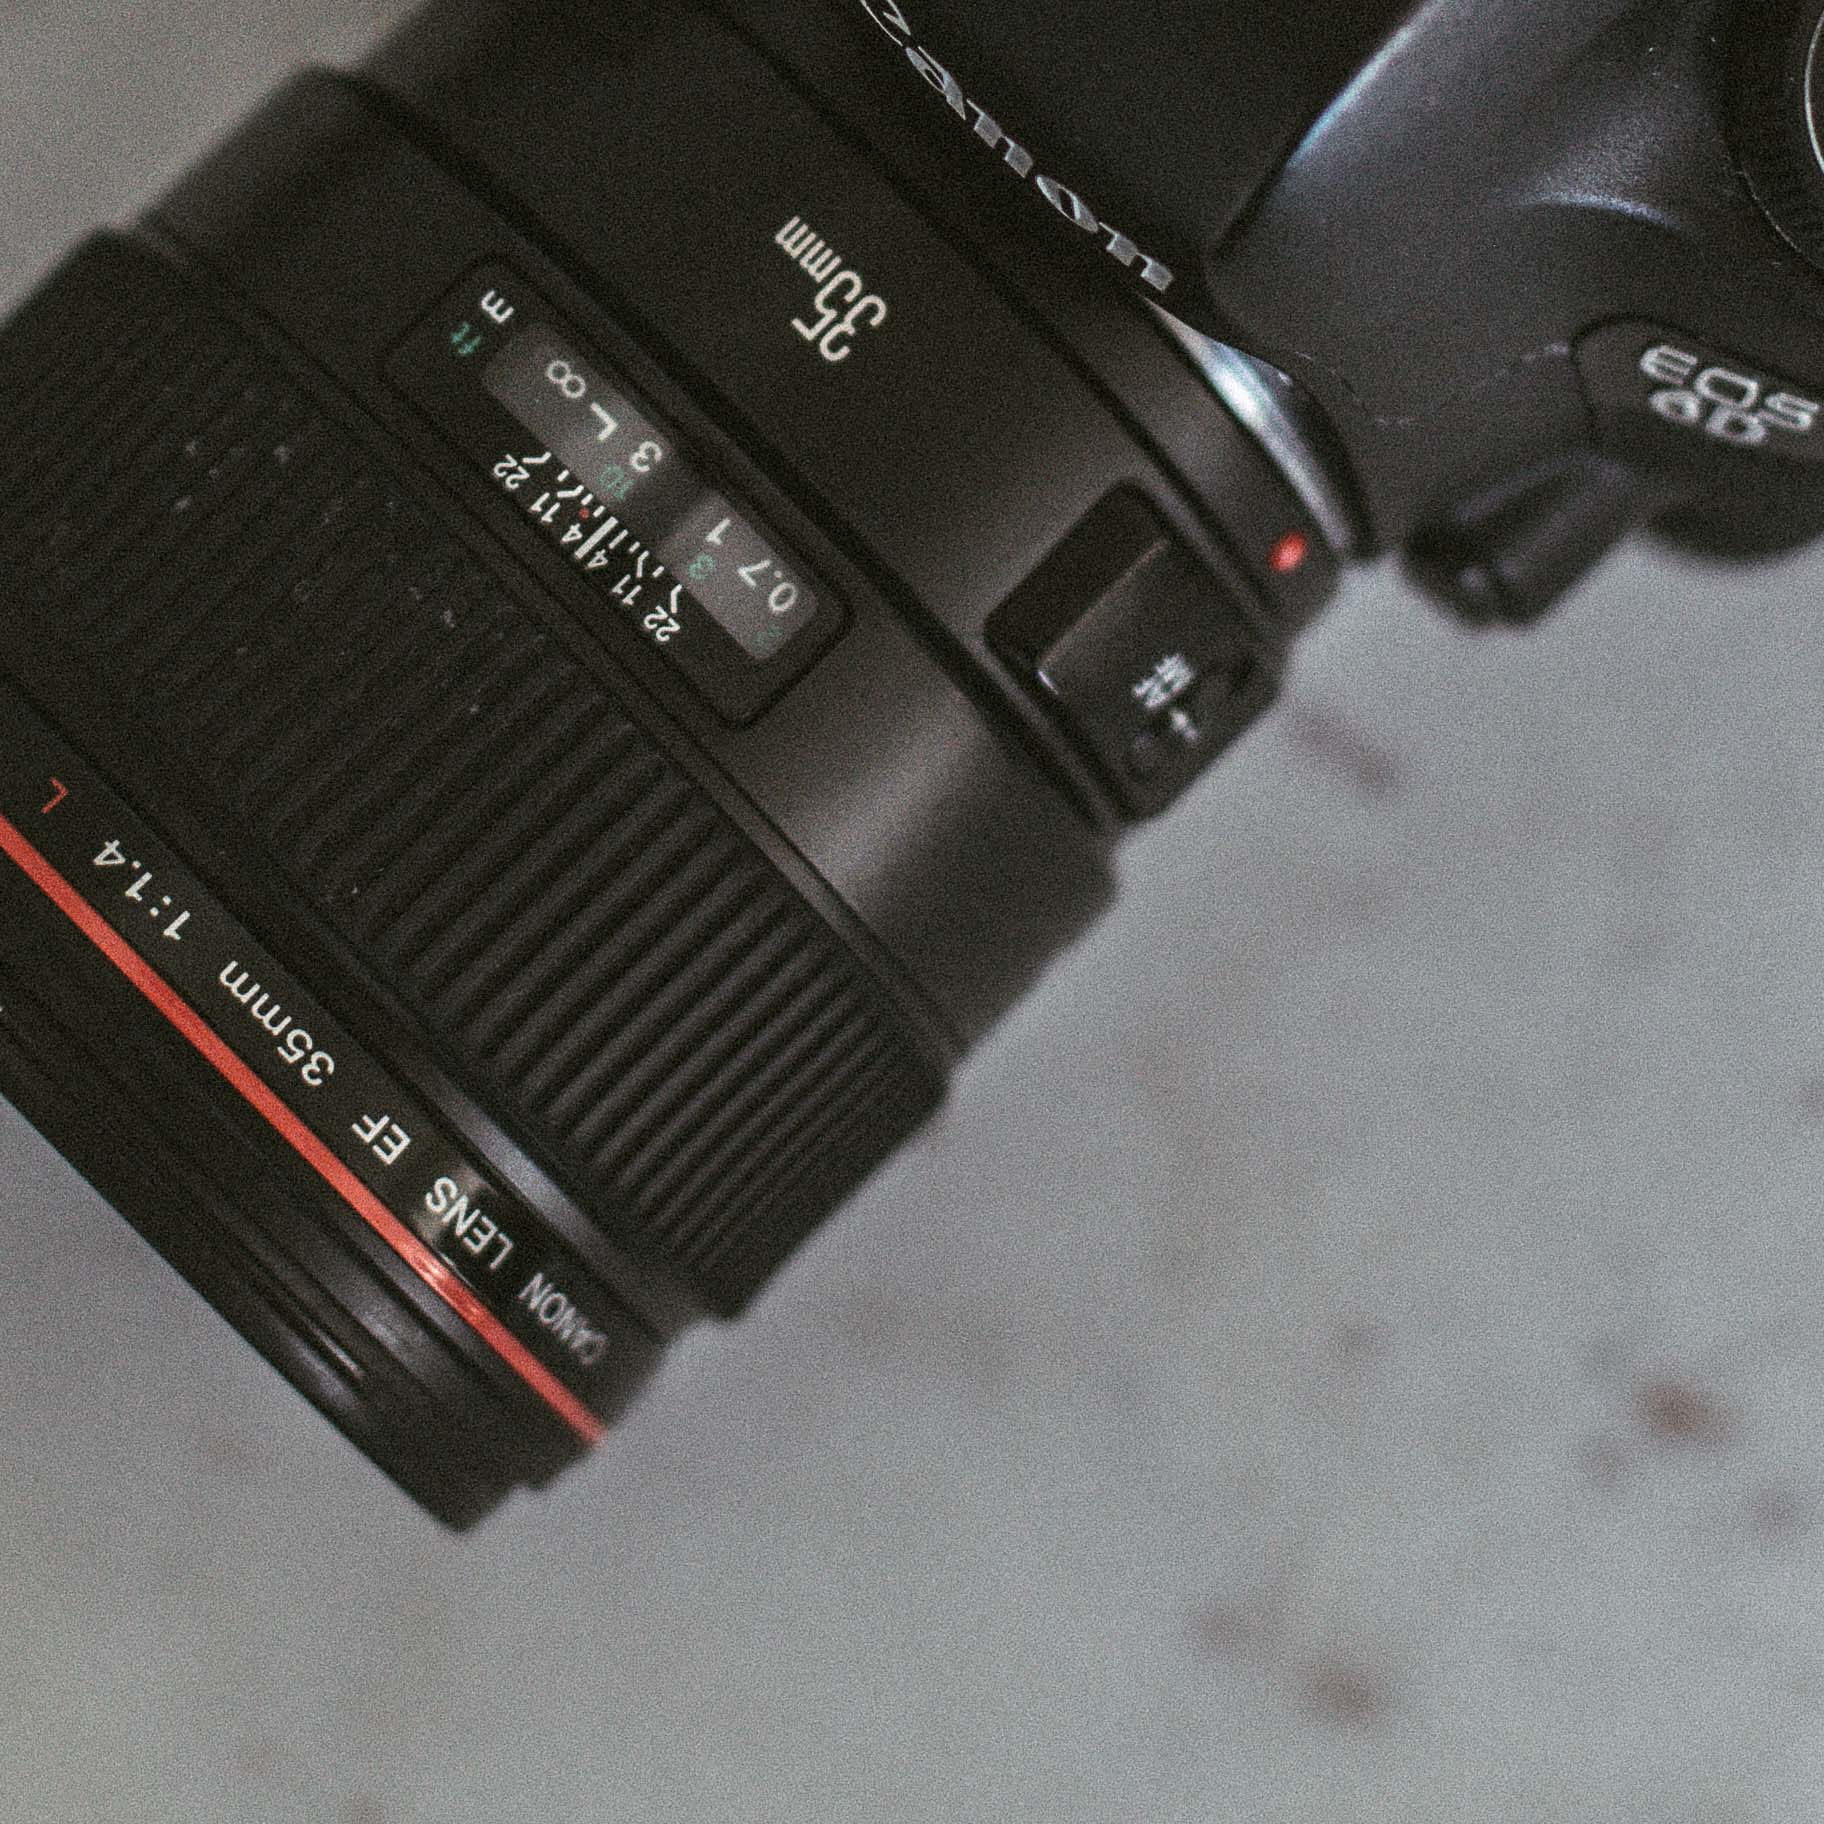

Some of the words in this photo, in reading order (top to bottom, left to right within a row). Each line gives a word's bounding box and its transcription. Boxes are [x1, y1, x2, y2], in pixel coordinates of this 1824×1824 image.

[479, 290, 514, 324] m
[774, 215, 888, 363] 35mm
[450, 322, 482, 358] ft
[1640, 346, 1821, 432] EOS
[493, 452, 531, 490] 22
[627, 440, 663, 475] 3
[528, 491, 562, 523] 11
[560, 522, 584, 544] 4
[705, 518, 731, 548] 1
[586, 547, 609, 569] 4
[612, 574, 643, 606] 11
[736, 558, 798, 615] 0.7
[643, 604, 681, 643] 22
[42, 778, 69, 814] L
[93, 840, 192, 941] 1:1.4
[219, 960, 336, 1088] 35mm
[352, 1114, 412, 1166] EF
[424, 1176, 513, 1269] LENS
[520, 1273, 607, 1365] CANON
